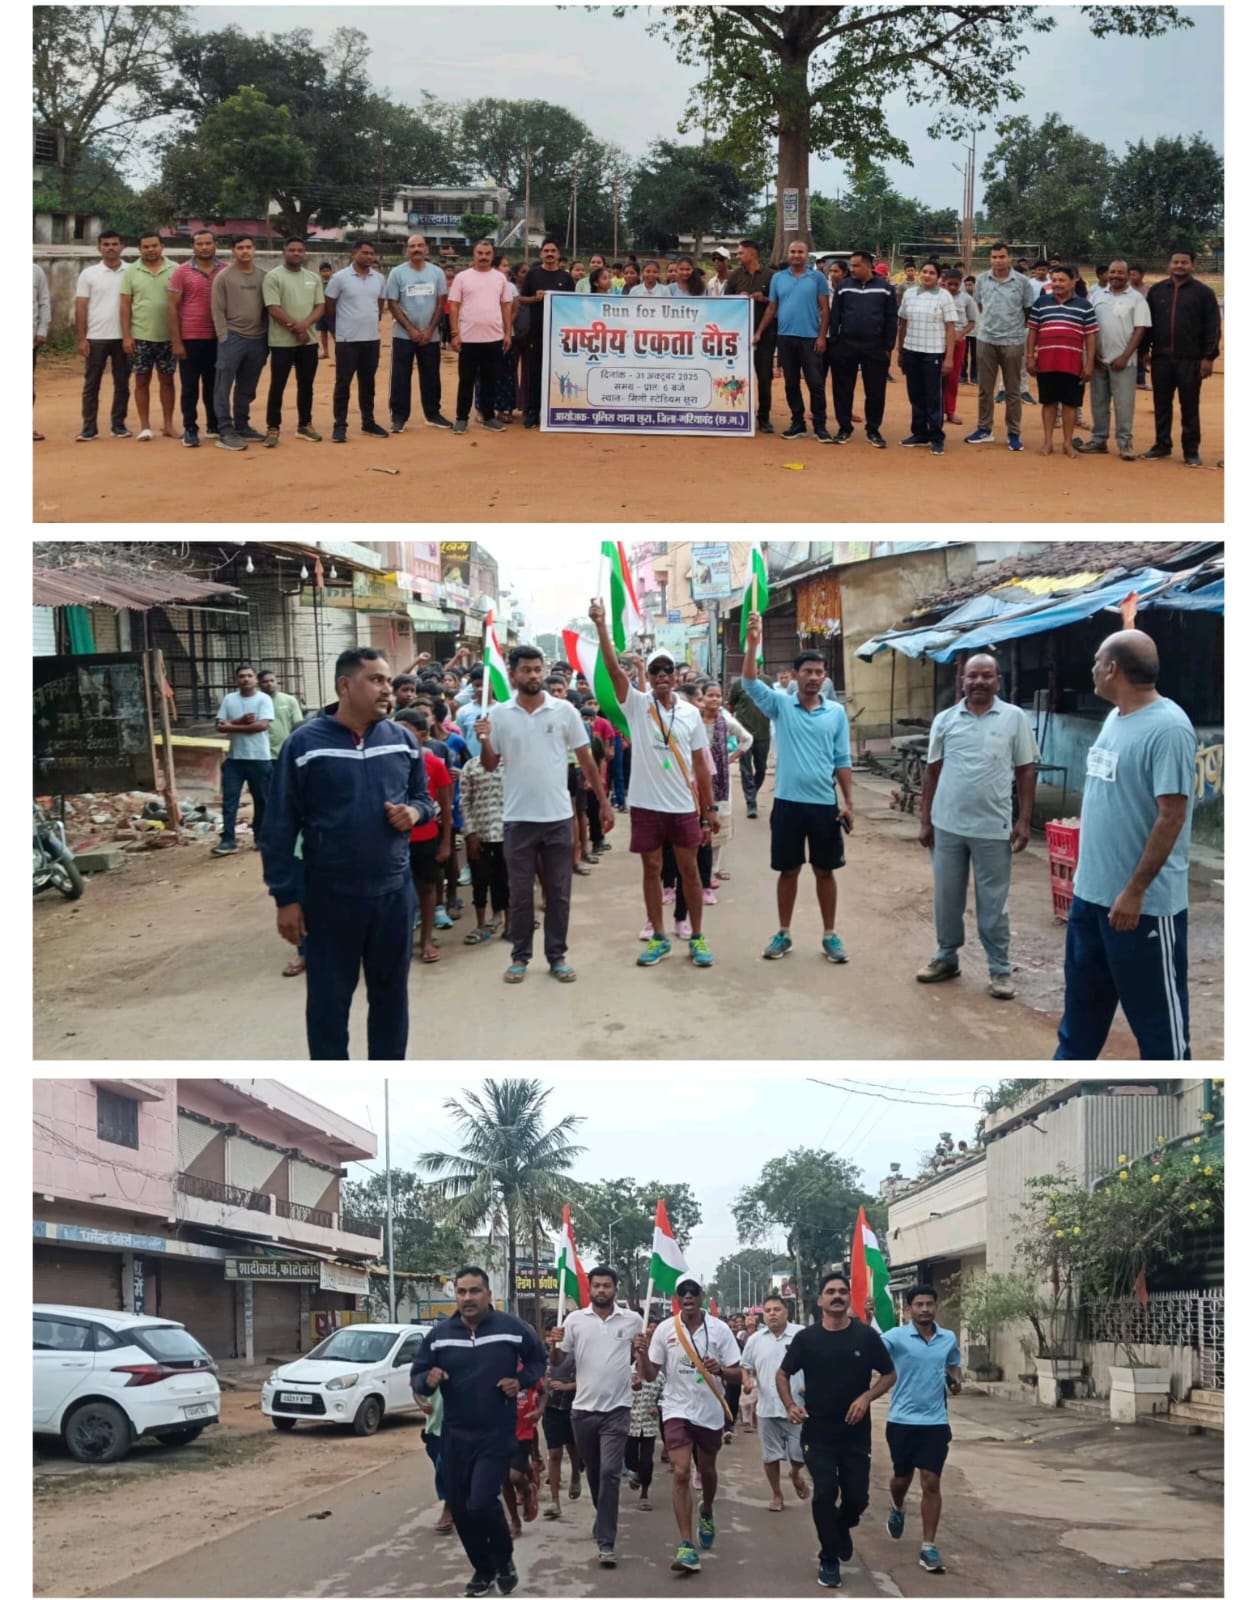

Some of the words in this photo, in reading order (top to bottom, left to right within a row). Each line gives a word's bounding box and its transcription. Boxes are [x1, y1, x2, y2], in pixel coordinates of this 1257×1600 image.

[602, 303, 630, 318] Run
[636, 304, 656, 318] for
[662, 304, 699, 321] Unity
[560, 321, 627, 361] राष्ट्रीय
[633, 330, 695, 356] एकता
[701, 324, 740, 365] दौड़
[600, 369, 626, 380] दिनांक
[646, 372, 675, 382] अक्टूबर
[678, 373, 699, 381] 2025
[614, 383, 634, 391] समय
[671, 382, 686, 392] बजे
[649, 393, 681, 405] स्टेडियम
[592, 410, 616, 425] पुलिस
[616, 413, 635, 423] थाना
